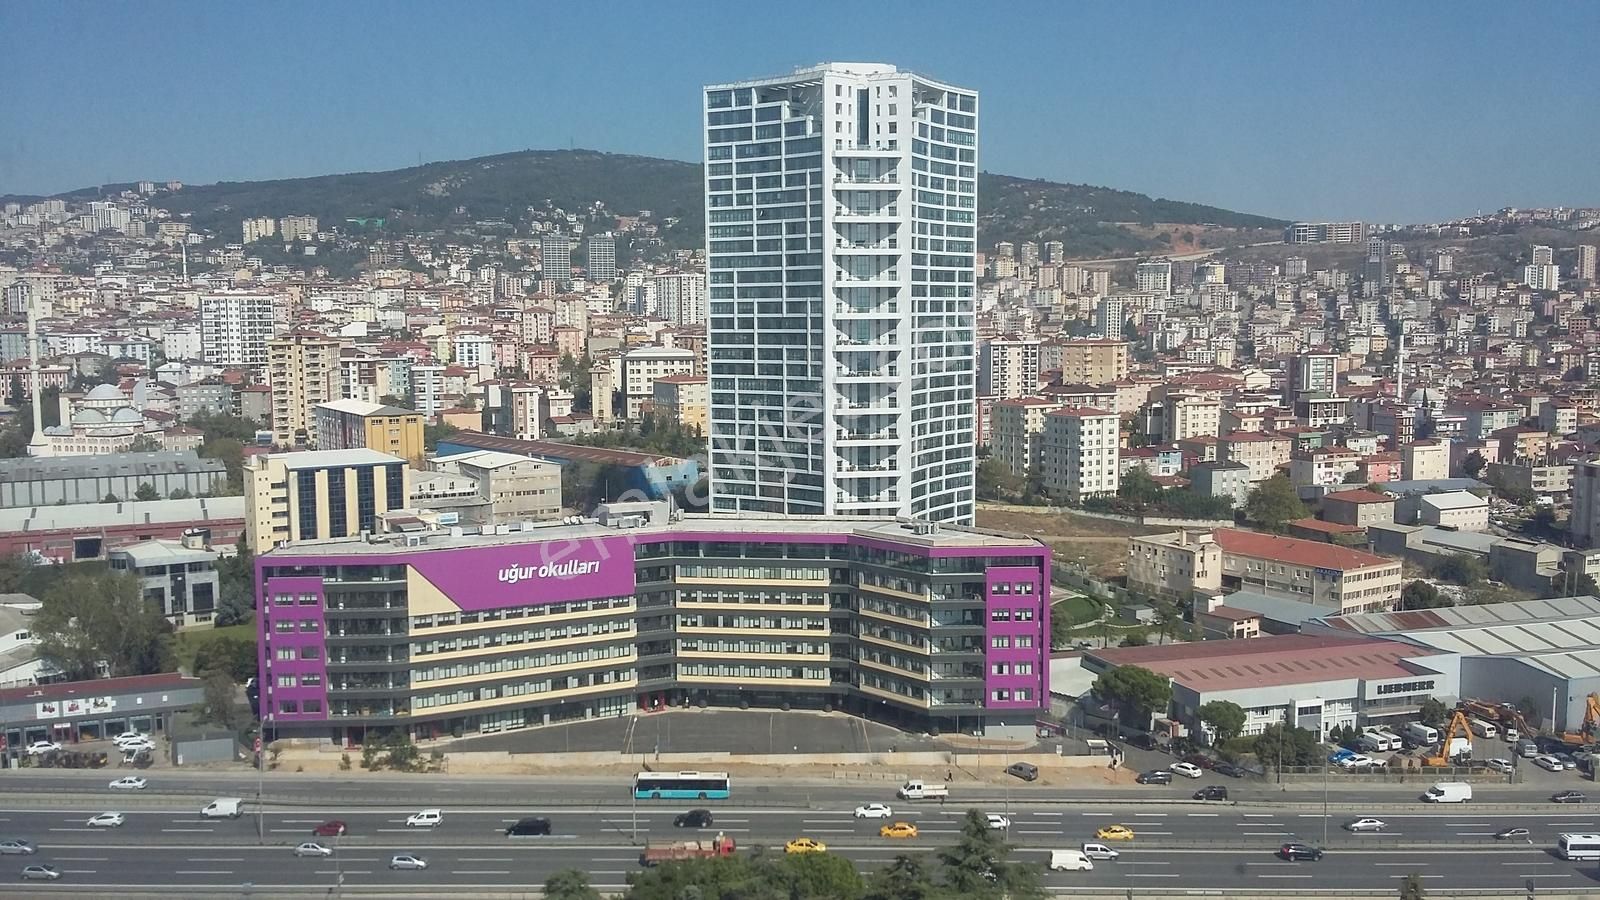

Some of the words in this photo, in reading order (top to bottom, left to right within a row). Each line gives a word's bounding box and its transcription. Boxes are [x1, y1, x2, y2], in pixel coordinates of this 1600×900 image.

[498, 563, 537, 583] uğur
[538, 559, 599, 577] okulları
[1377, 680, 1435, 695] LIEBHERR
